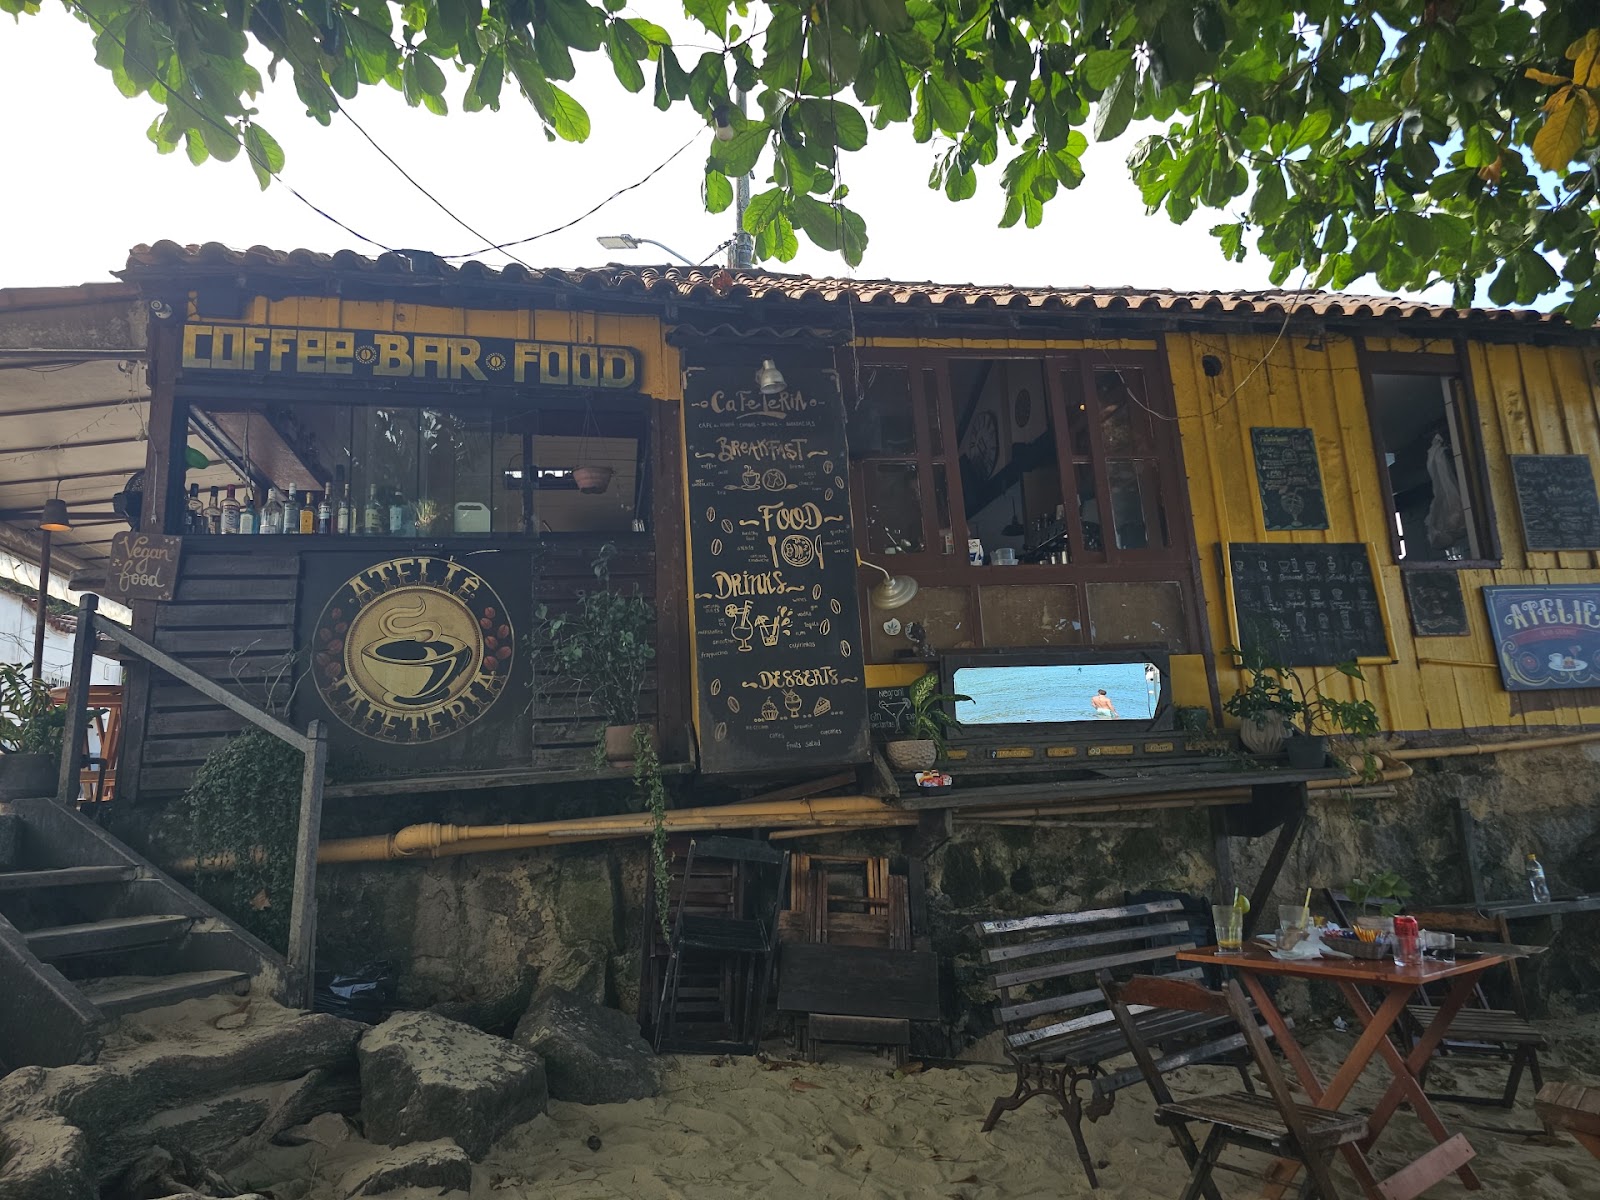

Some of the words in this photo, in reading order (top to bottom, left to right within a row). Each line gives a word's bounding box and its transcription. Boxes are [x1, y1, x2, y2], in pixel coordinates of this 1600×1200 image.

[372, 333, 489, 381] BAR
[513, 341, 636, 388] FOOD
[757, 501, 823, 532] FOOD
[118, 536, 173, 574] Vegan
[115, 560, 165, 592] food
[349, 558, 483, 608] ATELIÊ
[758, 666, 839, 690] DESSERTS
[320, 670, 507, 743] CAFETERIA
